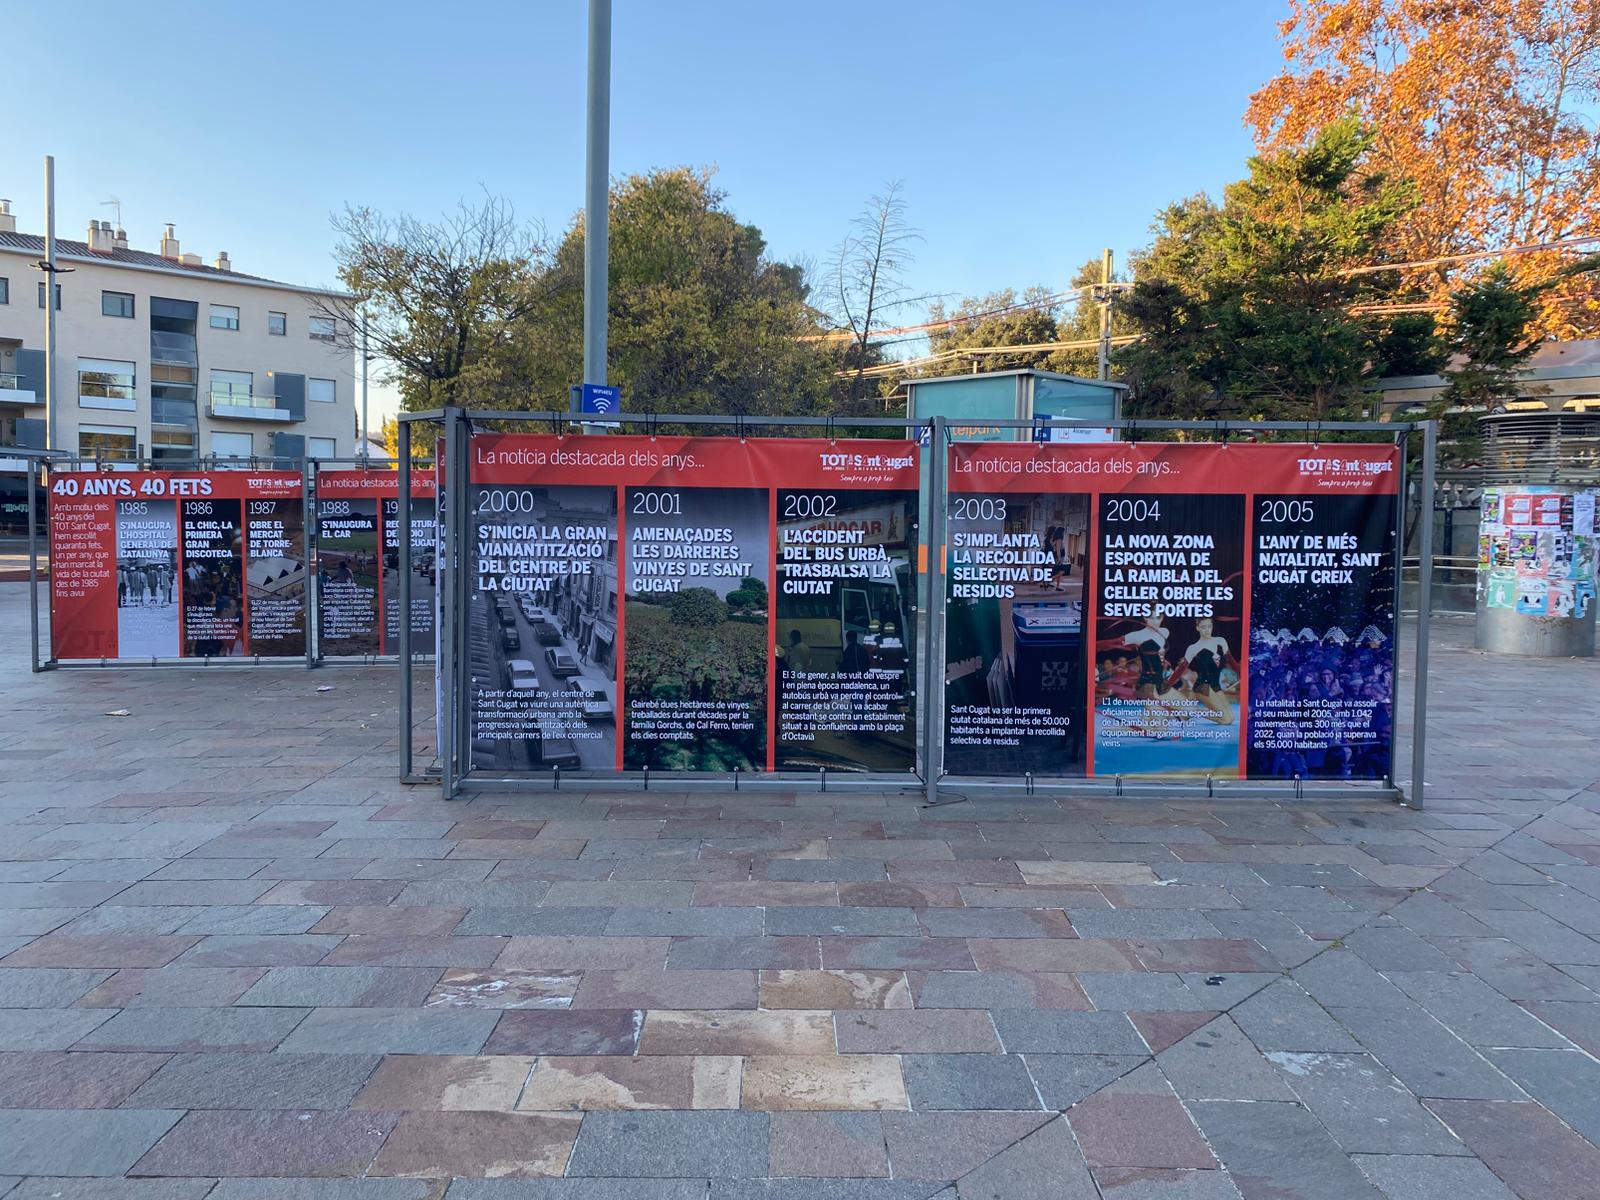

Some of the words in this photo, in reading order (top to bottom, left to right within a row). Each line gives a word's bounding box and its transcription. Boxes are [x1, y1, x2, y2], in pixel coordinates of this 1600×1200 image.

[478, 448, 494, 464] La
[500, 448, 546, 465] notícia
[551, 449, 624, 466] destacada
[630, 450, 658, 466] dels
[662, 454, 704, 471] anys...
[955, 456, 971, 472] La
[976, 457, 1021, 473] notícia
[1026, 457, 1100, 474] destacada
[1104, 458, 1132, 474] dels
[1137, 461, 1180, 478] anys...
[53, 479, 78, 495] 40
[83, 479, 136, 496] ANYS,
[140, 479, 165, 495] 40
[170, 478, 212, 495] FETS
[321, 479, 332, 488] La
[362, 478, 398, 488] destacad
[250, 502, 276, 514] 1987
[322, 502, 350, 514] 1988
[479, 490, 534, 512] 2000
[633, 492, 682, 514] 2001
[785, 495, 836, 516] 2002
[120, 502, 148, 515] 1985
[185, 502, 213, 515] 1986
[955, 498, 1006, 520] 2003
[1107, 500, 1161, 521] 2004
[1260, 500, 1314, 522] 2005
[185, 521, 195, 529] EL
[197, 521, 220, 529] CHIC,
[222, 521, 233, 529] LA
[250, 521, 272, 529] OBRE
[274, 521, 284, 529] EL
[185, 531, 222, 539] PRIMERA
[250, 530, 283, 538] MERCAT
[322, 530, 333, 538] EL
[334, 530, 351, 538] CAR
[542, 526, 560, 540] LA
[565, 527, 607, 540] GRAN
[632, 527, 732, 545] AMENAÇADES
[120, 540, 159, 548] GENERAL
[160, 540, 172, 548] DE
[186, 540, 210, 548] GRAN
[250, 540, 261, 548] DE
[262, 540, 293, 548] TORRE-
[1106, 535, 1124, 548] LA
[1129, 535, 1170, 548] NOVA
[1173, 535, 1214, 548] ZONA
[1304, 536, 1323, 549] DE
[1327, 532, 1358, 549] MÉS
[120, 550, 169, 558] CATALUNYA
[186, 550, 232, 558] DISCOTECA
[251, 549, 284, 557] BLANCA
[478, 541, 602, 558] VIANANTITZACIÓ
[632, 545, 660, 558] LES
[664, 545, 739, 559] DARRERES
[784, 546, 812, 560] DEL
[815, 547, 844, 561] BUS
[848, 544, 892, 562] URBÀ,
[953, 550, 971, 564] LA
[976, 550, 1055, 564] RECOLLIDA
[1106, 552, 1187, 566] ESPORTIVA
[1191, 552, 1210, 566] DE
[1259, 553, 1338, 568] NATALITAT,
[1341, 553, 1381, 566] SANT
[478, 560, 506, 574] DEL
[510, 560, 567, 574] CENTRE
[572, 561, 591, 574] DE
[632, 562, 686, 575] VINYES
[690, 562, 709, 576] DE
[713, 563, 752, 577] SANT
[783, 564, 869, 578] TRASBALSA
[872, 564, 892, 578] LA
[953, 567, 1029, 581] SELECTIVA
[1034, 568, 1052, 581] DE
[1105, 569, 1124, 582] LA
[1128, 569, 1190, 583] RAMBLA
[1195, 570, 1222, 583] DEL
[1259, 570, 1307, 584] CUGAT
[1311, 570, 1353, 584] CREIX
[478, 578, 498, 591] LA
[501, 578, 552, 591] CIUTAT
[632, 578, 680, 592] CUGAT
[783, 580, 833, 594] CIUTAT
[953, 584, 1015, 598] RESIDUS
[1104, 586, 1158, 600] CELLER
[1163, 586, 1202, 600] OBRE
[1206, 587, 1233, 600] LES
[1104, 603, 1150, 617] SEVES
[1156, 603, 1213, 617] PORTES
[950, 705, 967, 713] Sant
[969, 705, 990, 715] Cugat
[1014, 706, 1021, 714] la
[1022, 706, 1051, 716] primera
[972, 716, 1002, 724] catalana
[1004, 716, 1012, 725] de
[1014, 716, 1030, 725] més
[1032, 717, 1041, 725] de
[1042, 717, 1069, 725] 50.000
[950, 726, 984, 734] habitants
[991, 727, 1025, 736] implantar
[1027, 727, 1033, 735] la
[1035, 727, 1065, 736] recollida
[982, 737, 992, 745] de
[993, 737, 1019, 745] residus
